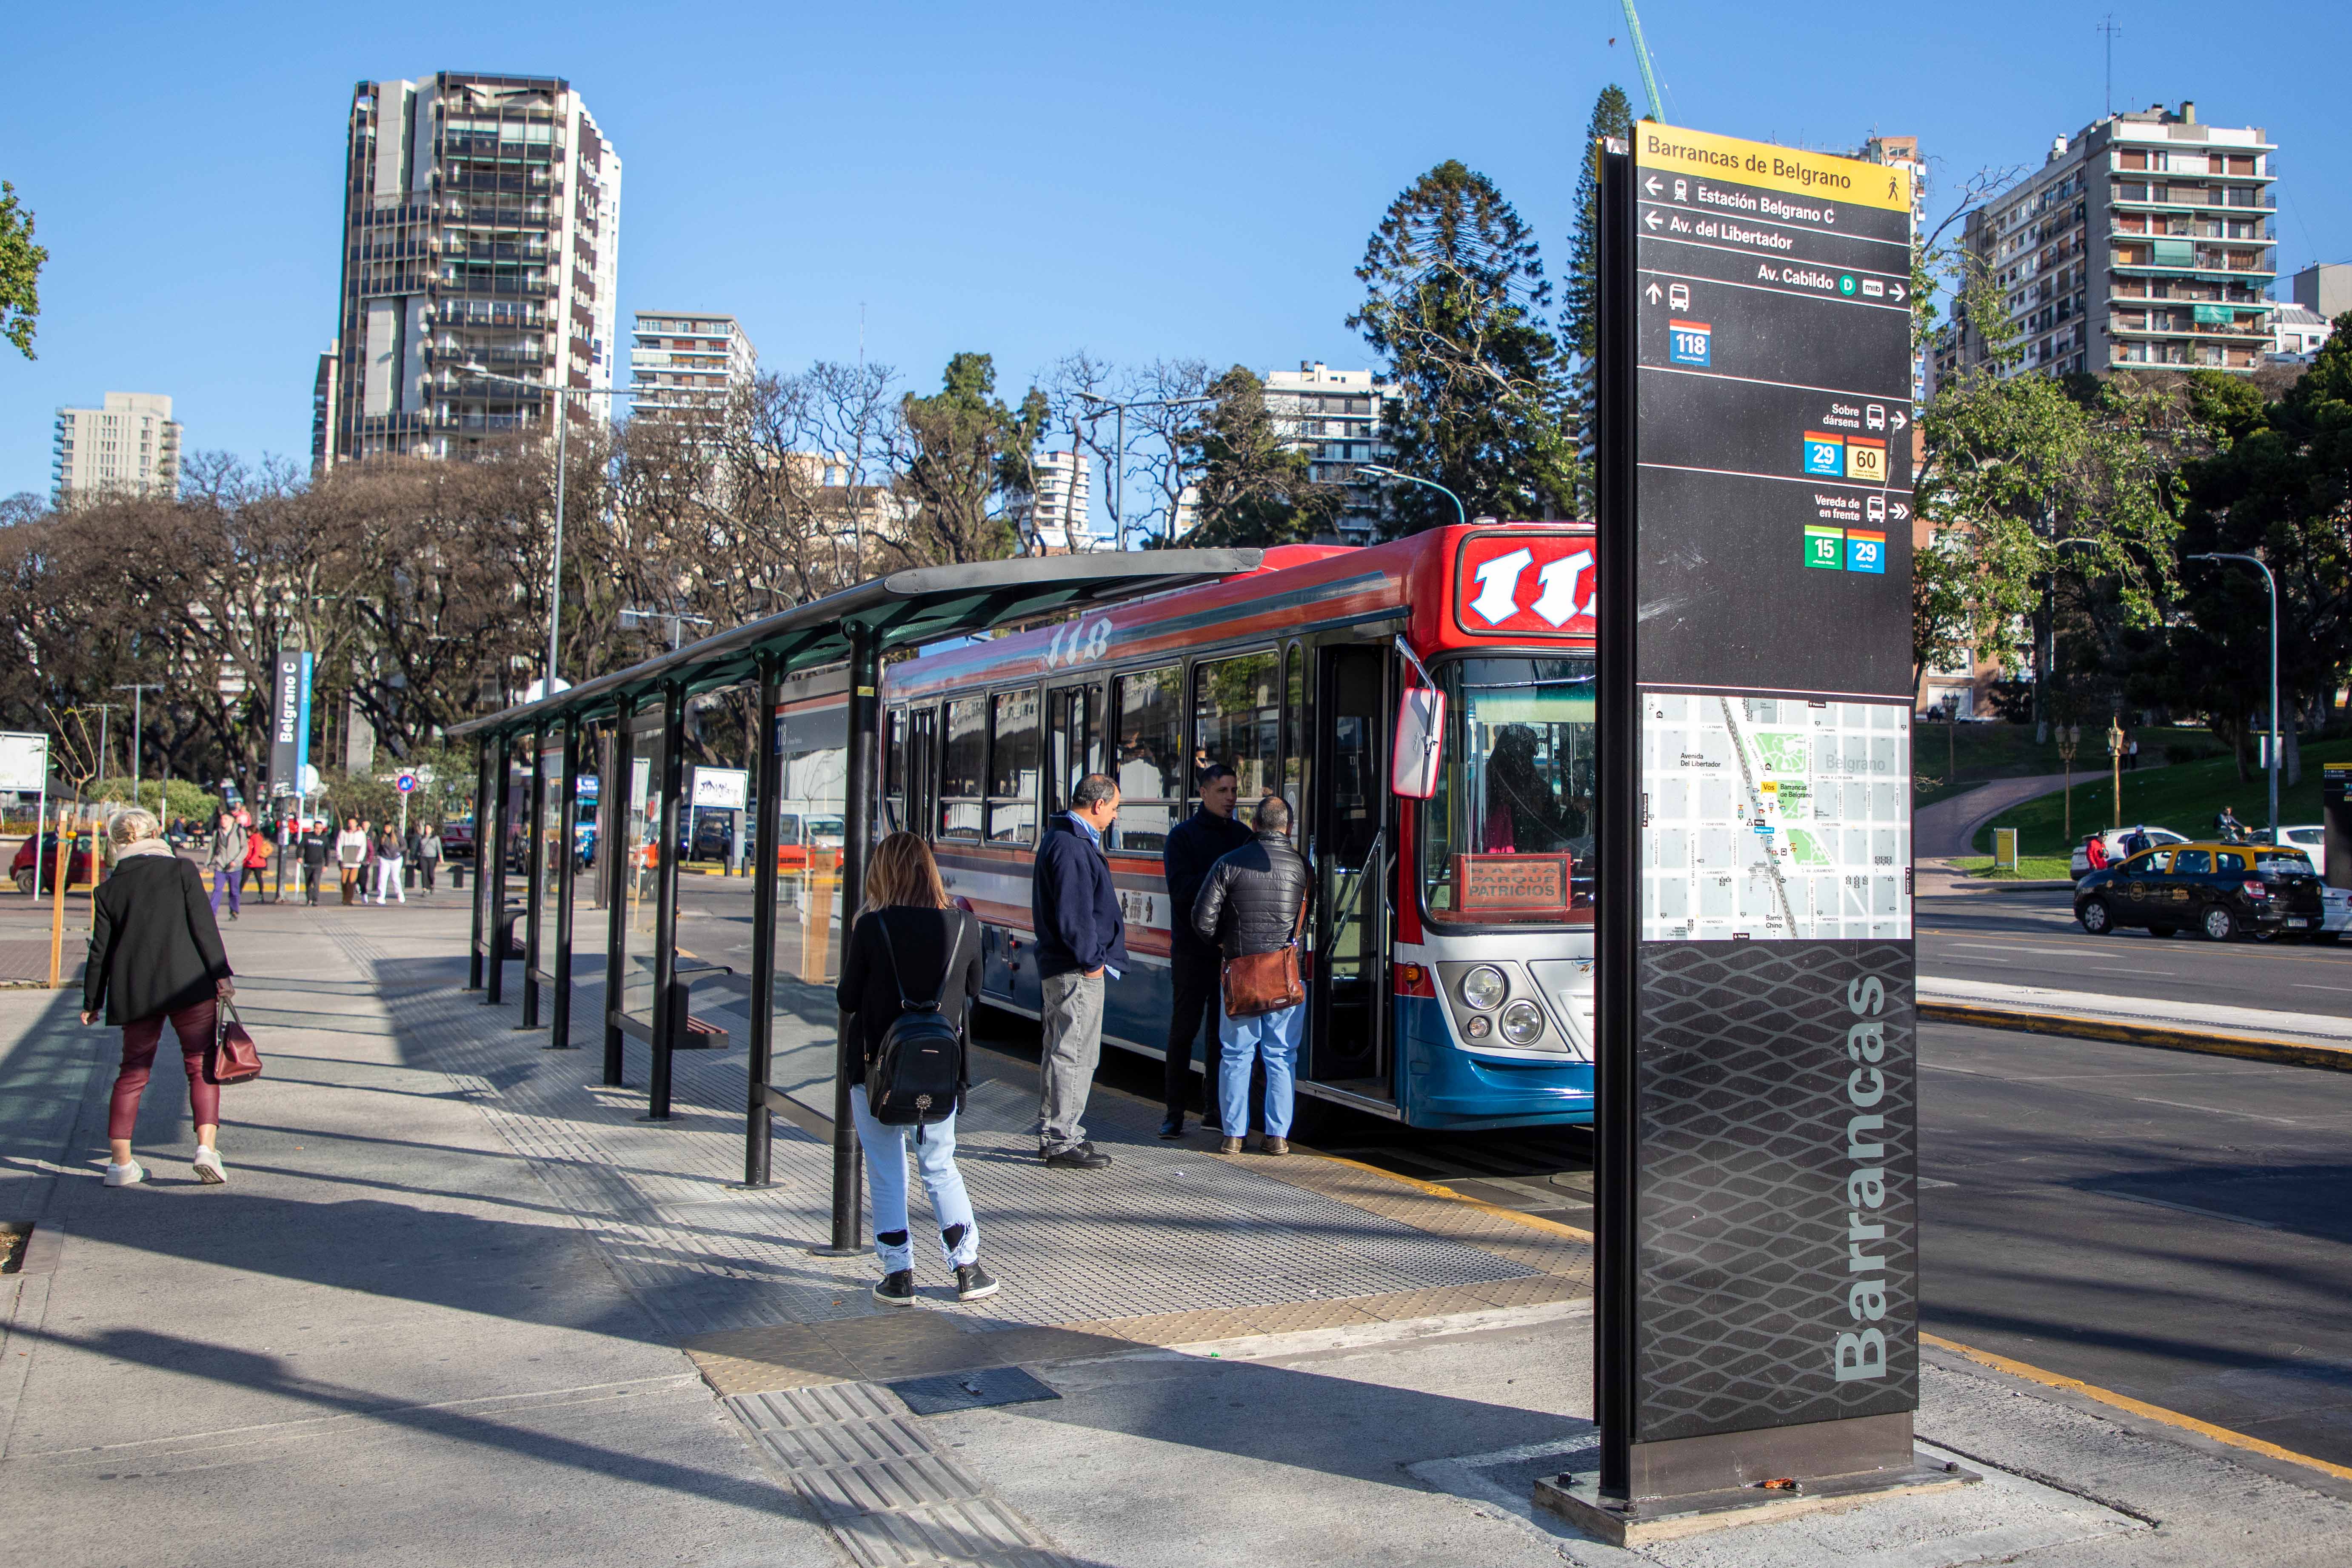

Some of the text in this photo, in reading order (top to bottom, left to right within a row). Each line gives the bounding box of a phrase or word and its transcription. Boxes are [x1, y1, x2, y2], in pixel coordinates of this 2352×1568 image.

[1648, 135, 1851, 189] Barrancas de Belgrano
[1698, 186, 1835, 224] Estación Belgrano C
[1670, 216, 1793, 250] Av. del Libertador
[1757, 264, 1778, 281] Av.
[1782, 268, 1834, 290] Cabildo
[1844, 279, 1853, 291] D
[1676, 333, 1706, 355] 118
[1832, 403, 1859, 416] Sobre
[1823, 414, 1859, 428] dársena
[1813, 445, 1835, 465] 29
[1857, 450, 1876, 469] 60
[1815, 494, 1860, 509] Vereda de
[1819, 508, 1861, 521] en frente
[1815, 539, 1834, 558] 15
[1855, 543, 1877, 562] 29
[1469, 547, 1596, 628] 11
[1047, 617, 1113, 669] 118
[279, 662, 297, 743] Belgrano C
[777, 724, 787, 746] 118
[1826, 754, 1885, 773] Belgrano
[1471, 876, 1554, 884] PARQUE
[1469, 885, 1555, 896] PATRICIOS
[1835, 976, 1887, 1382] Barrancas
